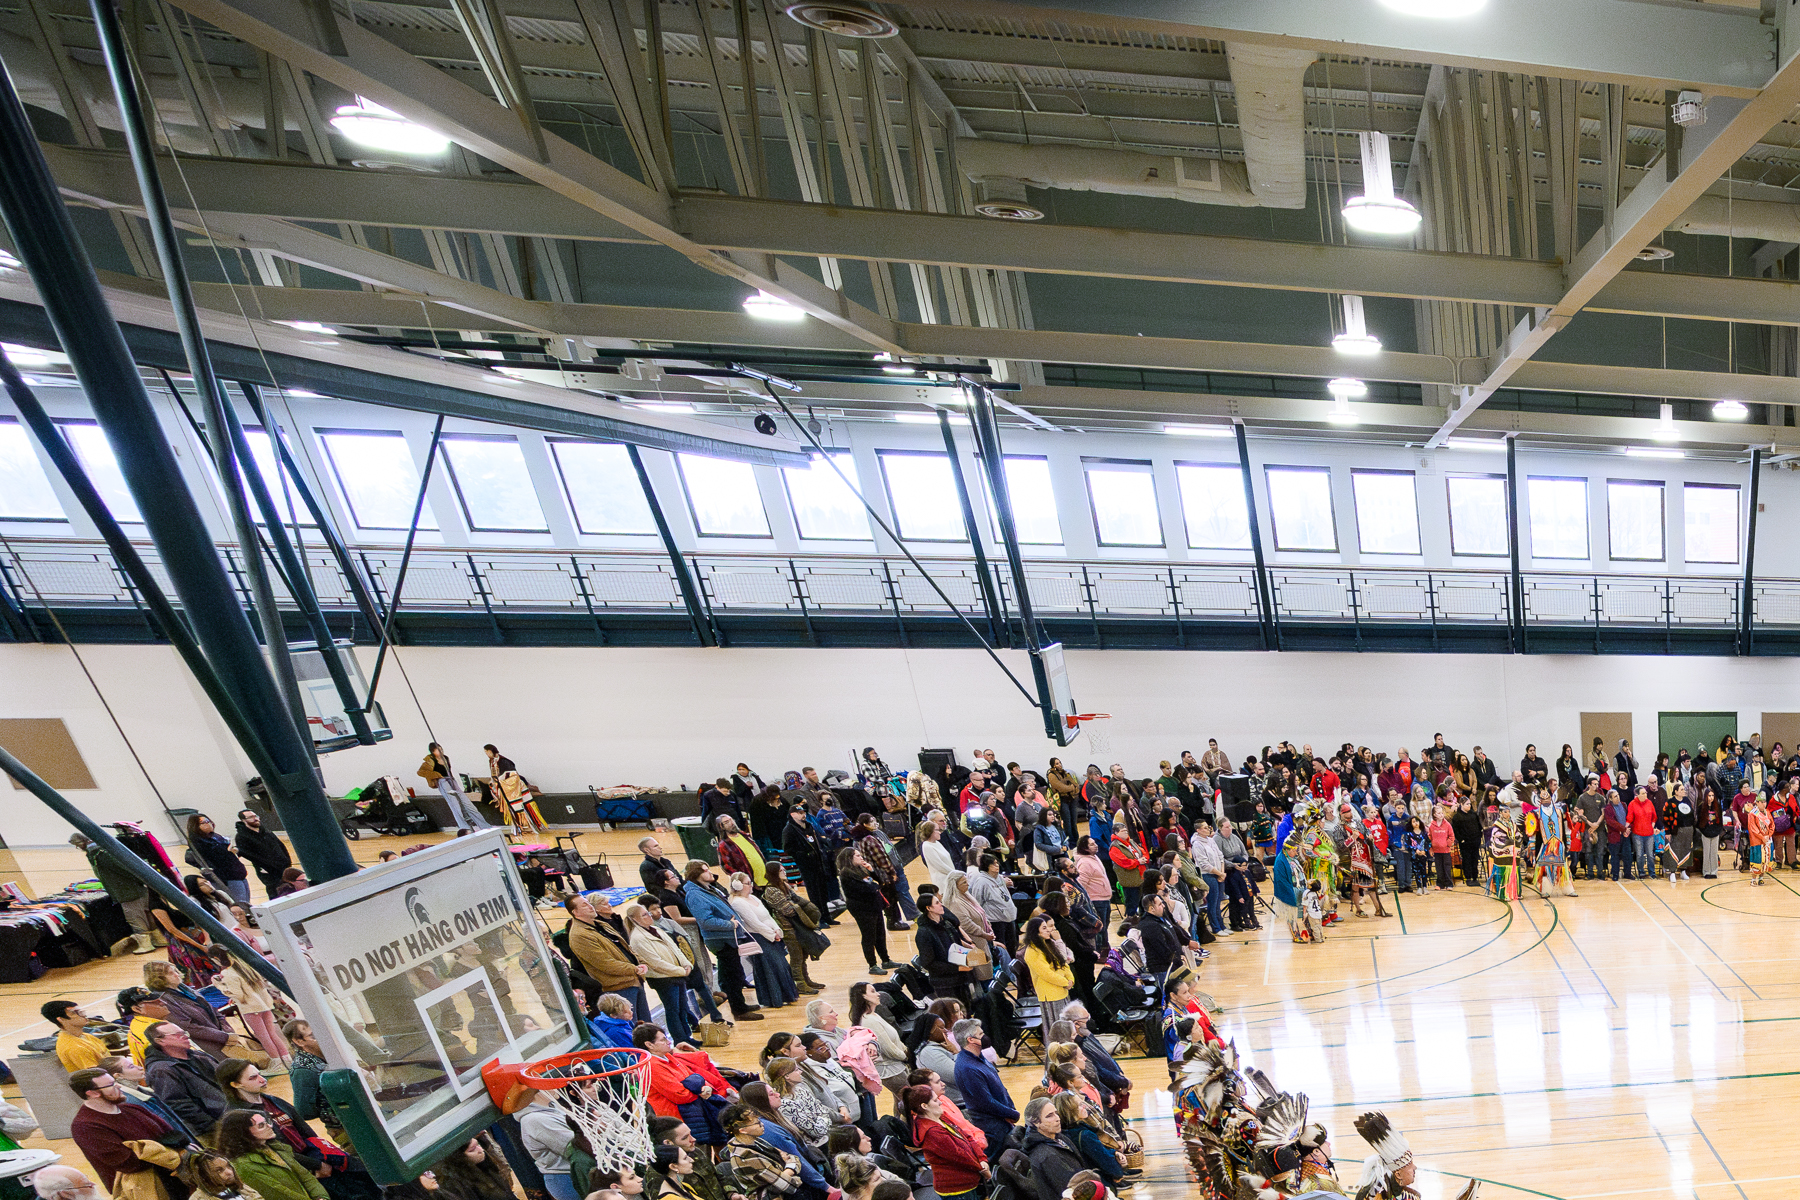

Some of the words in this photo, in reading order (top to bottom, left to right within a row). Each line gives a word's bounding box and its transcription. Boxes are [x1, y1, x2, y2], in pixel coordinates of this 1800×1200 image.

[332, 957, 366, 991] DO
[364, 939, 406, 977] NOT
[402, 919, 456, 960] HANG
[453, 907, 480, 936] ON
[476, 894, 510, 926] RIM
